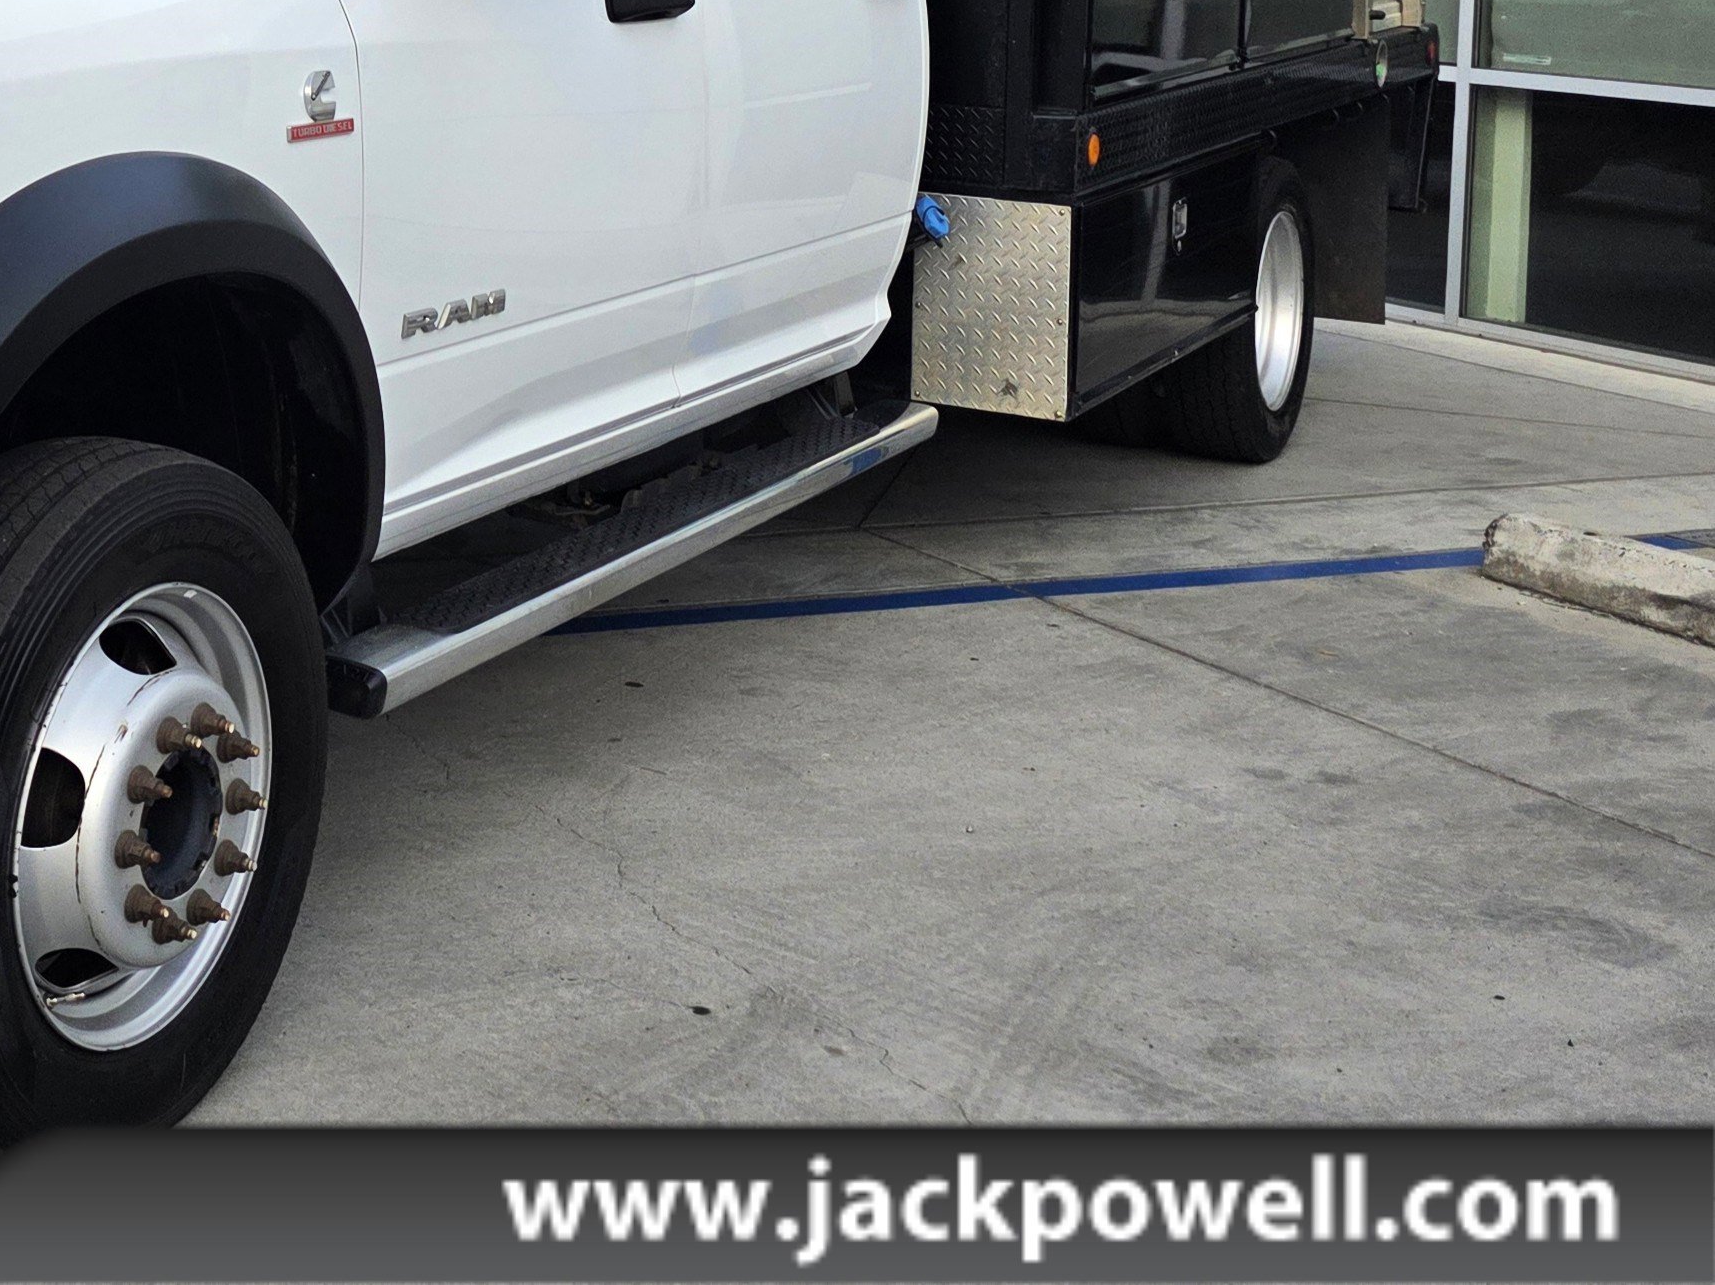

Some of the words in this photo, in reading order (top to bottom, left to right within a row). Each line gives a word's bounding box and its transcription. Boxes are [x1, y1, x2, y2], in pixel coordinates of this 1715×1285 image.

[292, 125, 322, 138] TURBO
[322, 121, 353, 134] DIESEL
[400, 288, 506, 340] RAM
